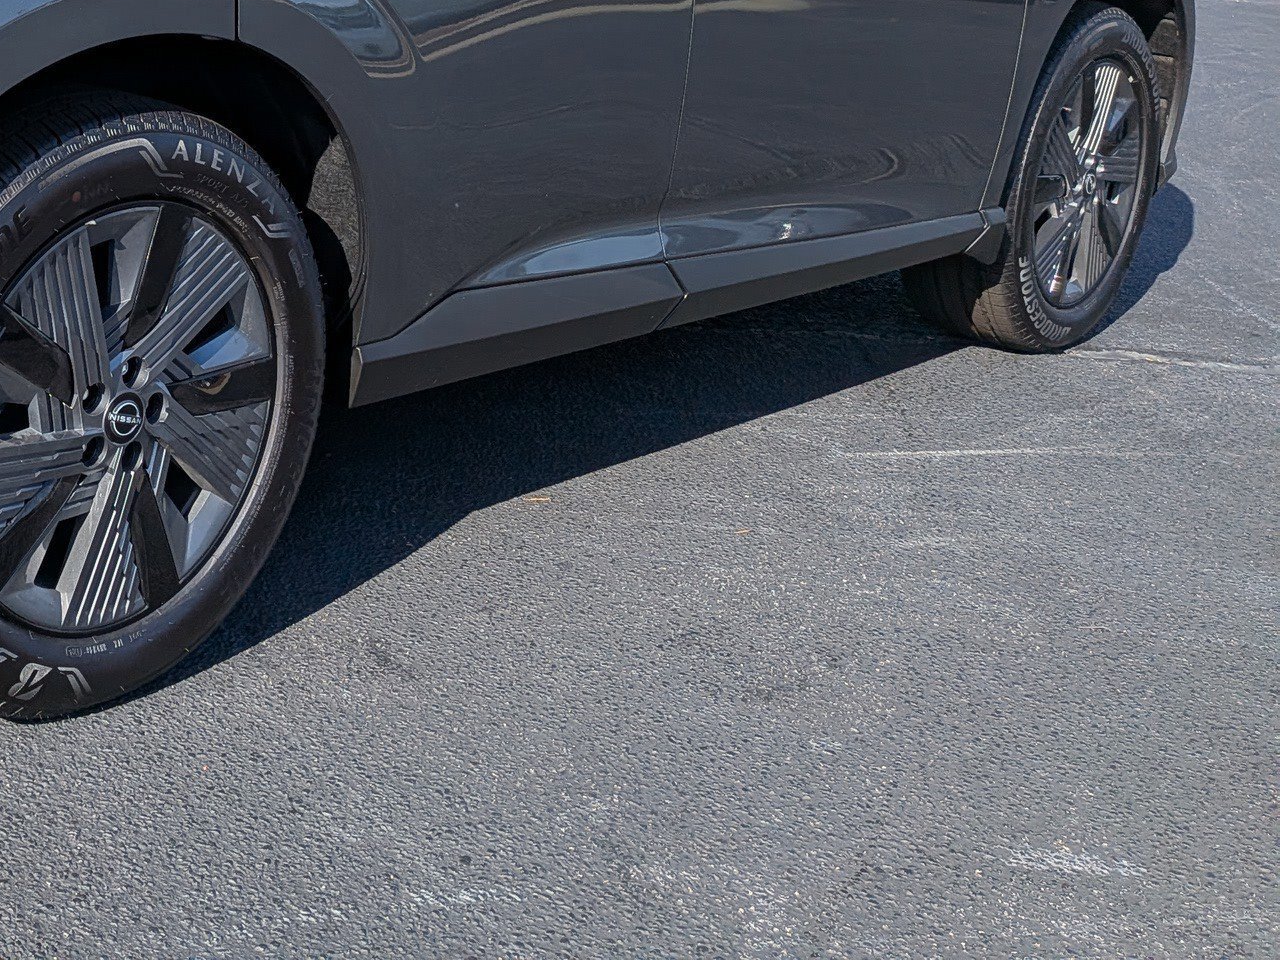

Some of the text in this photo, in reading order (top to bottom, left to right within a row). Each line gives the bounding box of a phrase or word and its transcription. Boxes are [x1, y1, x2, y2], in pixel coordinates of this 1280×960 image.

[171, 139, 276, 215] ALENZA
[1019, 256, 1072, 341] BRIDGESTONE
[108, 411, 142, 424] NISSAN
